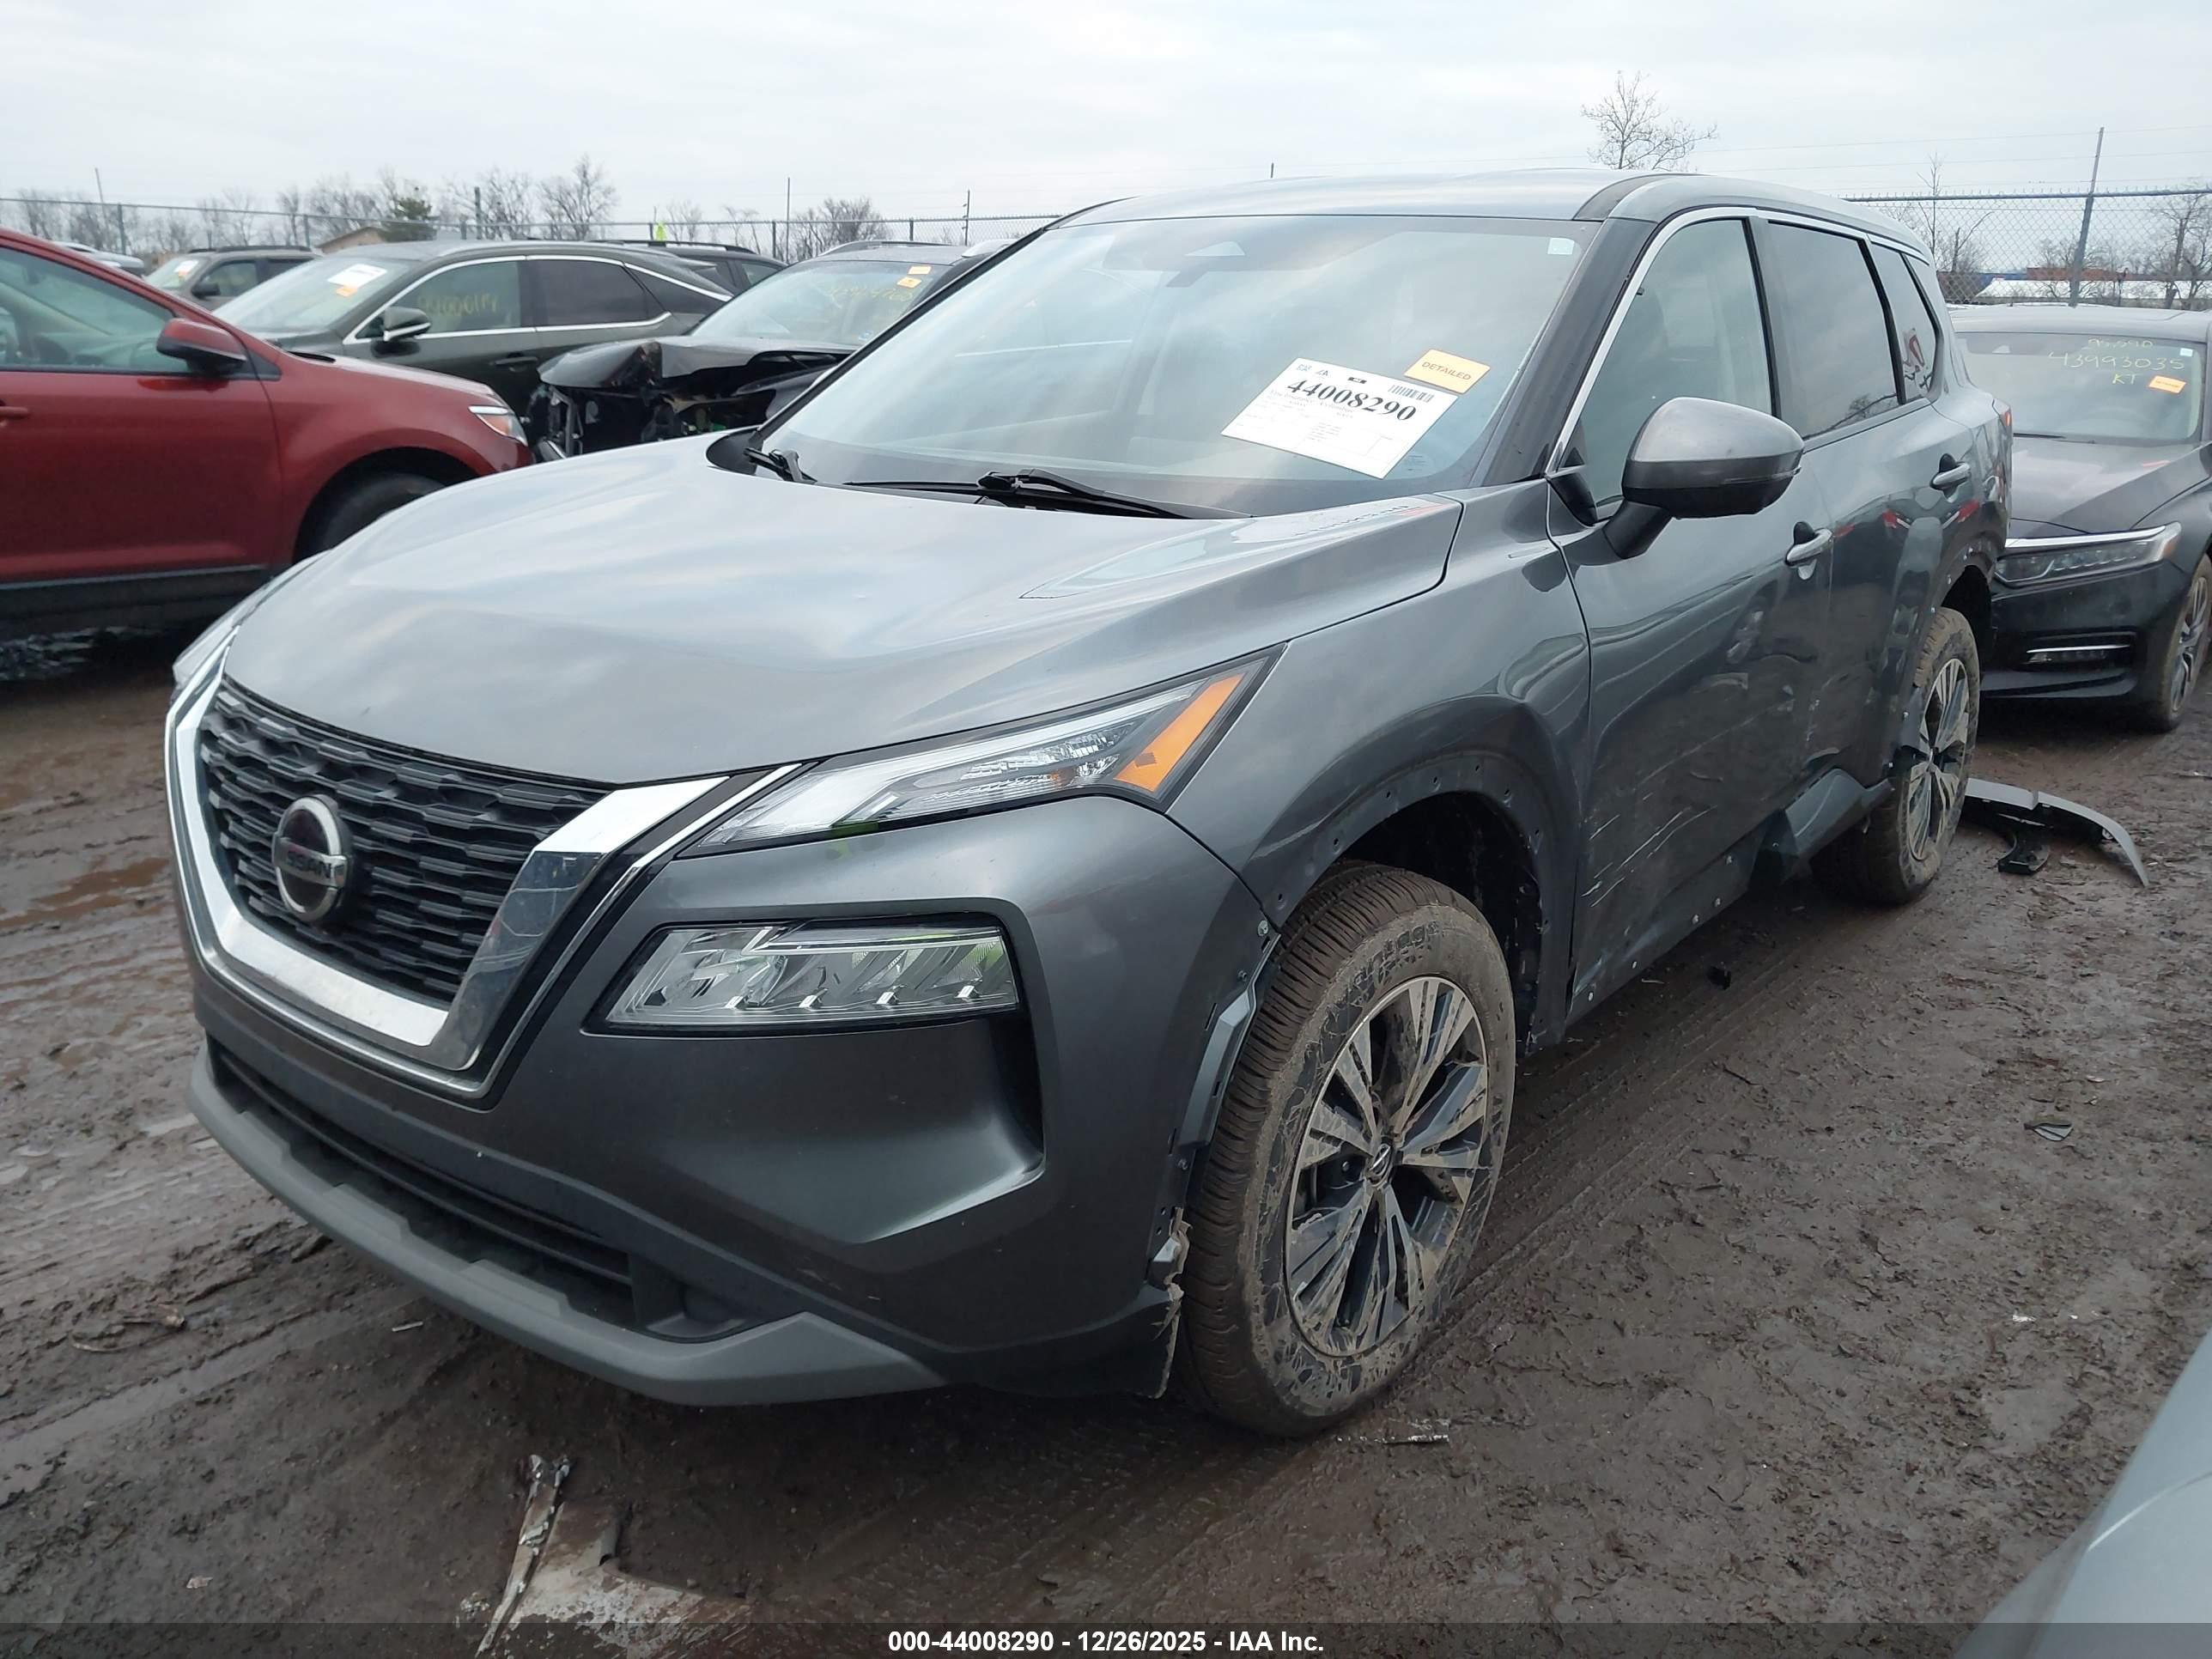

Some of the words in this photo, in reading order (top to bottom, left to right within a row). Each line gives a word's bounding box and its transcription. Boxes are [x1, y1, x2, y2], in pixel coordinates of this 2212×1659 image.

[1421, 361, 1473, 381] DETAILED
[2048, 351, 2185, 371] 43993035
[2112, 373, 2144, 385] KT
[1287, 379, 1417, 421] 44008290
